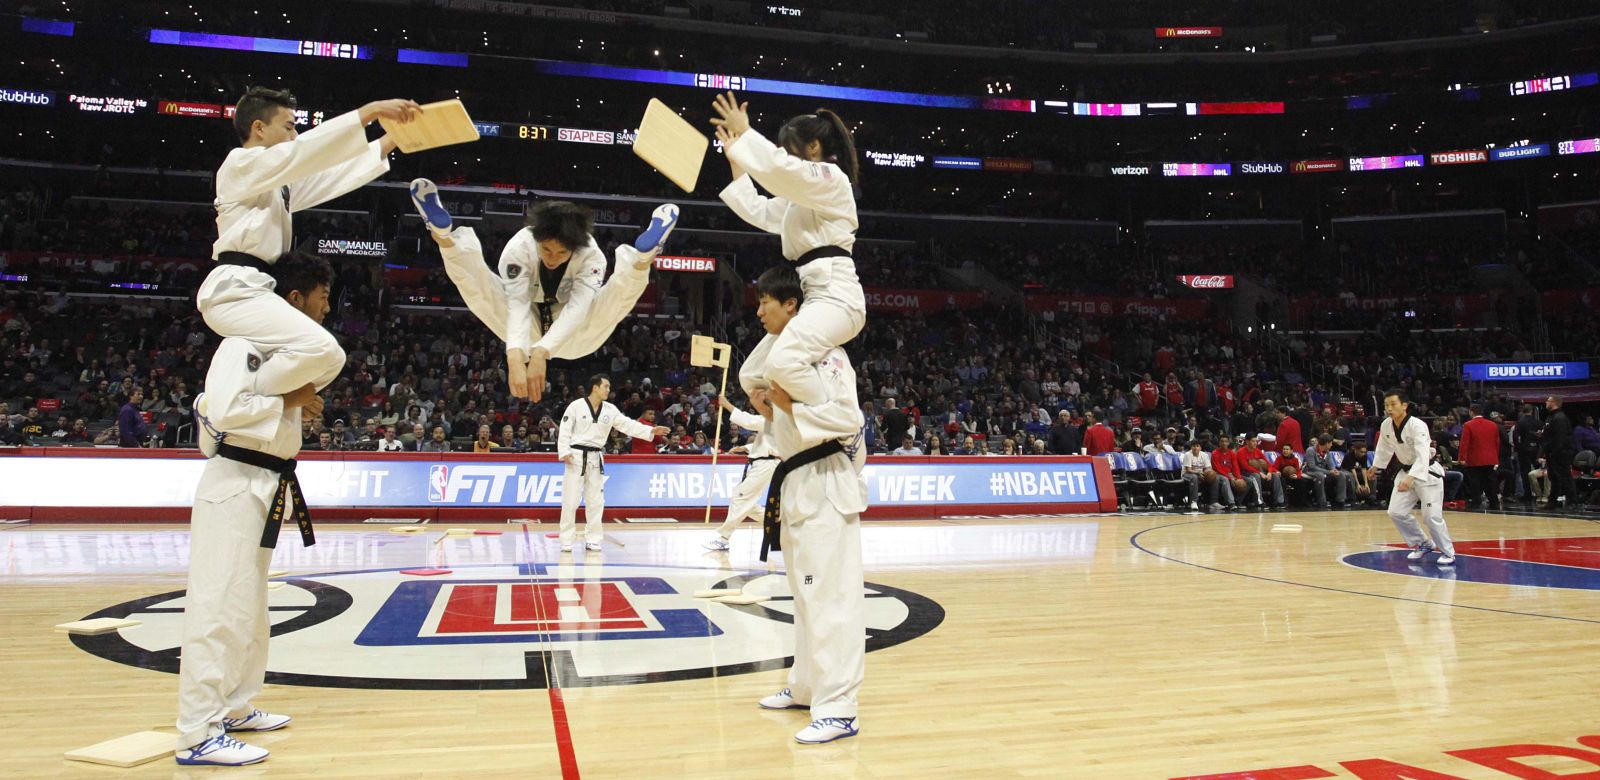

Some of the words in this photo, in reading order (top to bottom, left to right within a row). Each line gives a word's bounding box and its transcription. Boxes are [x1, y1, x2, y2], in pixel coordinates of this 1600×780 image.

[69, 94, 104, 105] Paloma
[106, 97, 134, 108] Valley
[103, 104, 135, 113] JROTC
[179, 106, 214, 114] McDonald's
[518, 126, 547, 140] 8:37
[559, 129, 612, 144] STAPLES
[1558, 140, 1573, 149] OTT
[866, 151, 893, 161] Paloma
[893, 153, 915, 162] Valley
[1517, 147, 1541, 156] LIGHT
[1349, 158, 1364, 166] DAL
[1431, 152, 1486, 163] TOSHIBA
[1241, 163, 1284, 174] StubHub
[1404, 160, 1420, 168] NHL
[1111, 165, 1149, 176] verizon
[1163, 169, 1177, 177] TOR
[318, 239, 339, 249] SAN
[346, 241, 387, 251] MANUEL
[655, 258, 714, 271] TOSHIBA
[1488, 366, 1519, 378] BUD
[1521, 365, 1564, 377] LIGHT
[649, 472, 741, 501] #NBAF
[878, 476, 957, 502] WEEK
[990, 471, 1088, 497] #NBAFIT
